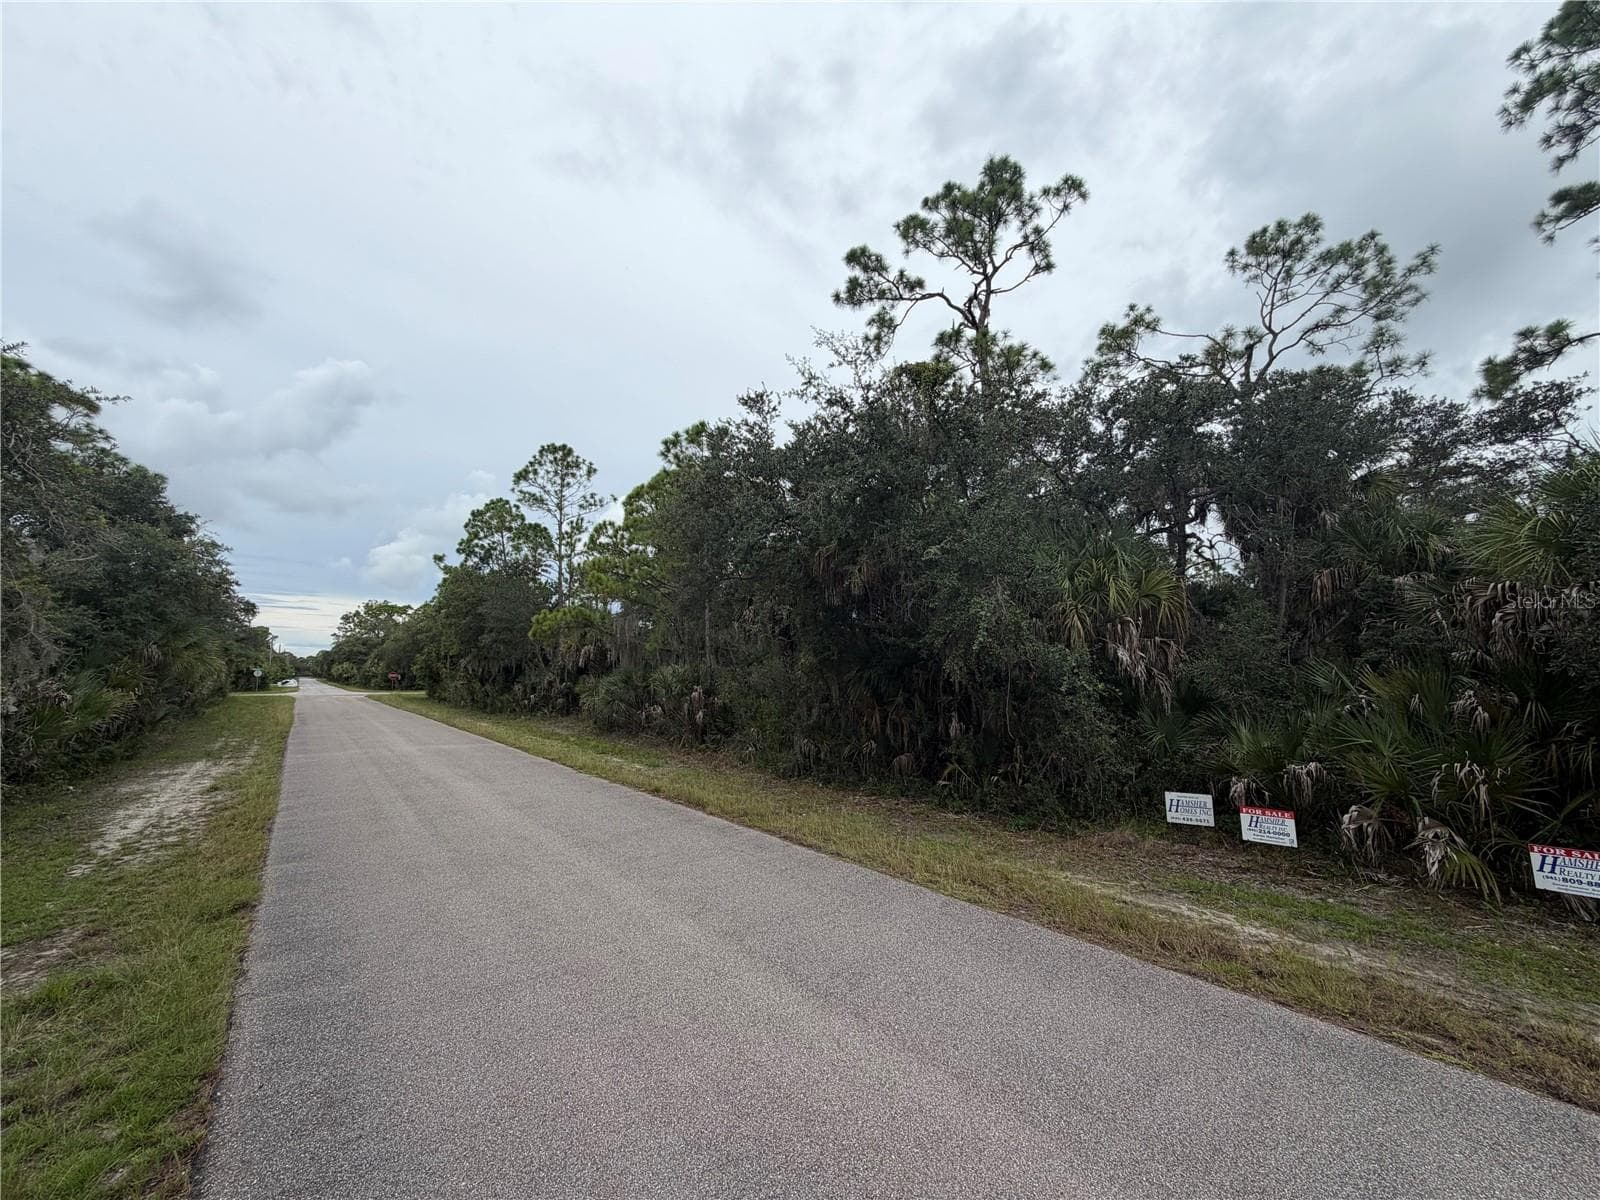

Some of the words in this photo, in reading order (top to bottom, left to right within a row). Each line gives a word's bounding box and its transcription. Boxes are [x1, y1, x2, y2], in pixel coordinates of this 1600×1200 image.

[1168, 799, 1207, 812] HAMSHER
[1242, 807, 1262, 815] FOR
[1265, 810, 1292, 819] SALE
[1532, 845, 1567, 856] FOR
[1571, 850, 1600, 860] SAL
[1536, 855, 1600, 875] HAMSHE
[1559, 867, 1596, 881] REALTY
[1562, 877, 1600, 888] 809-88
